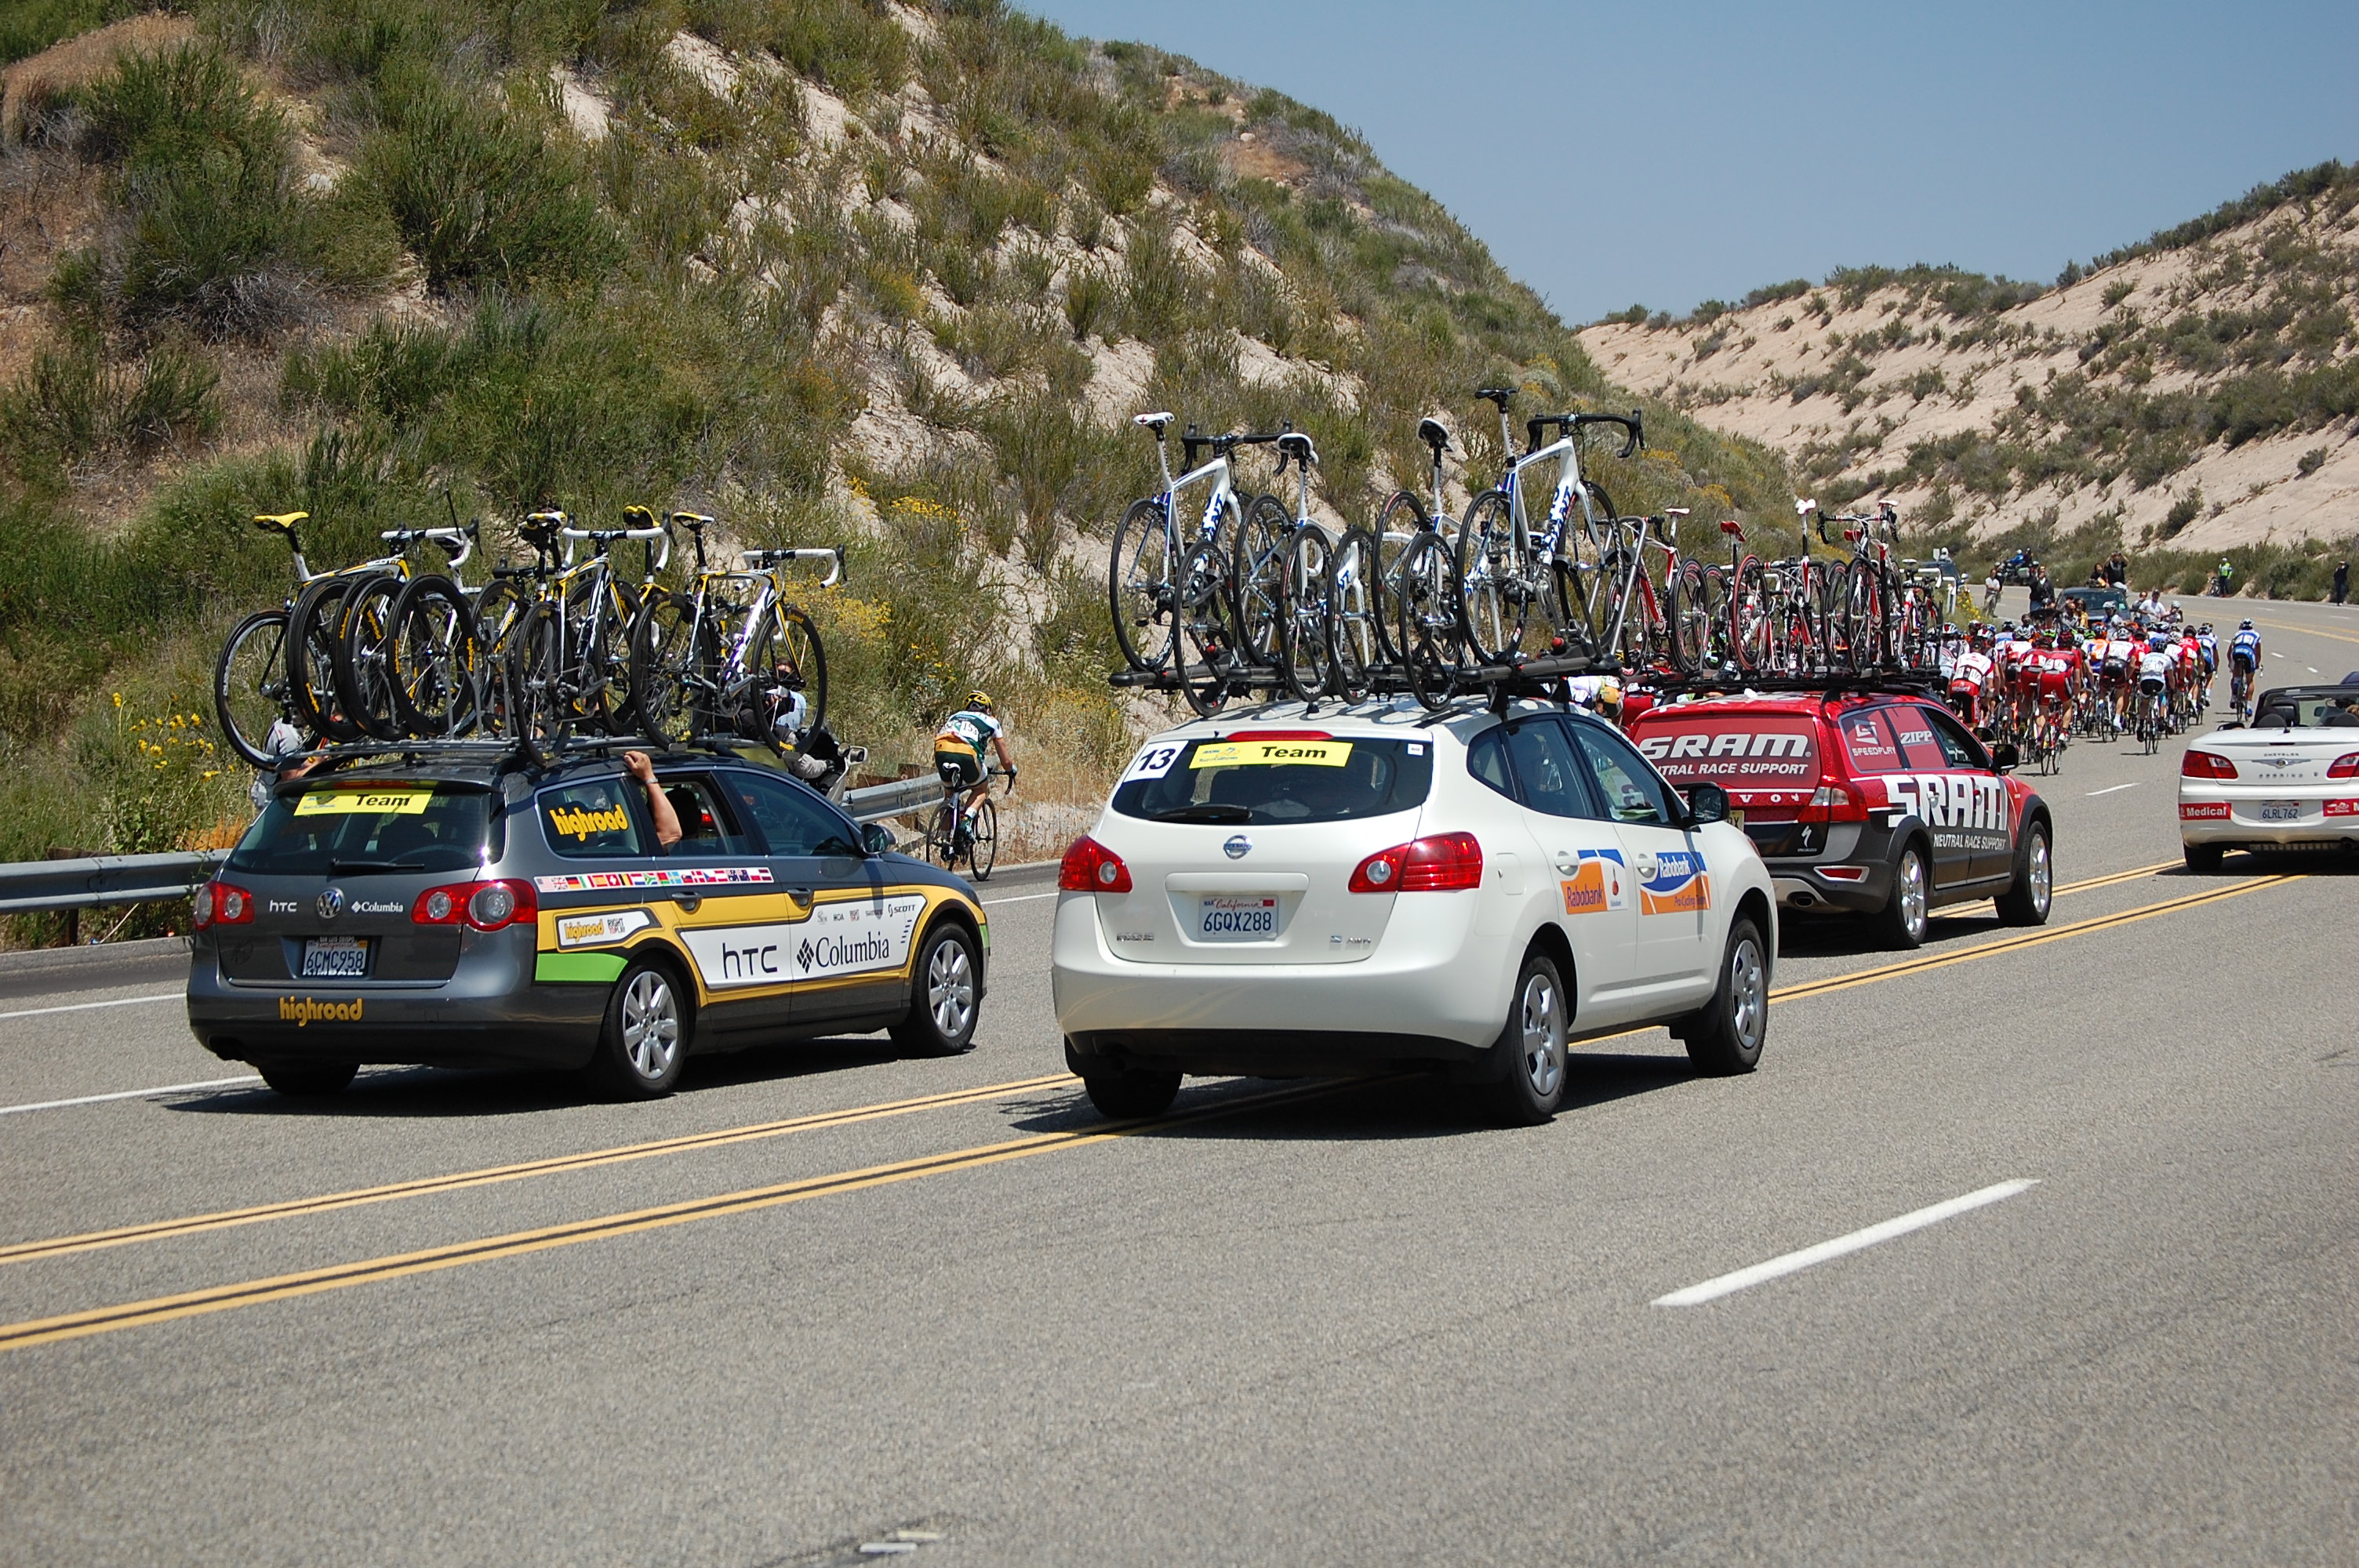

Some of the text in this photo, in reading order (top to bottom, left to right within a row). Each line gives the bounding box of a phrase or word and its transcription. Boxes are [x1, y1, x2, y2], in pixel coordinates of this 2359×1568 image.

[1639, 733, 1808, 760] SRAM
[1900, 730, 1933, 744] ZIPP
[1138, 748, 1176, 771] 13
[1261, 746, 1327, 759] Team
[1852, 746, 1896, 757] SPEEDPLAY
[1657, 763, 1808, 775] TRAL RACE SUPPORT
[355, 793, 411, 807] Team
[1882, 773, 2008, 832] SRAM
[2186, 806, 2227, 817] Medical
[2261, 808, 2299, 820] 6LRL762
[548, 804, 629, 842] highroad
[1933, 833, 2007, 851] NEUTRAL RACE SUPPORT
[1658, 854, 1692, 879] Rabobank
[1567, 882, 1604, 907] Rabobank
[361, 901, 404, 913] Columbia
[893, 904, 916, 913] SCOTT
[1216, 898, 1260, 911] California
[564, 918, 605, 943] highroad
[1203, 911, 1272, 933] 6GQX288
[816, 930, 889, 968] Columbia
[306, 950, 365, 971] 6CMC958
[278, 996, 364, 1028] highroad
